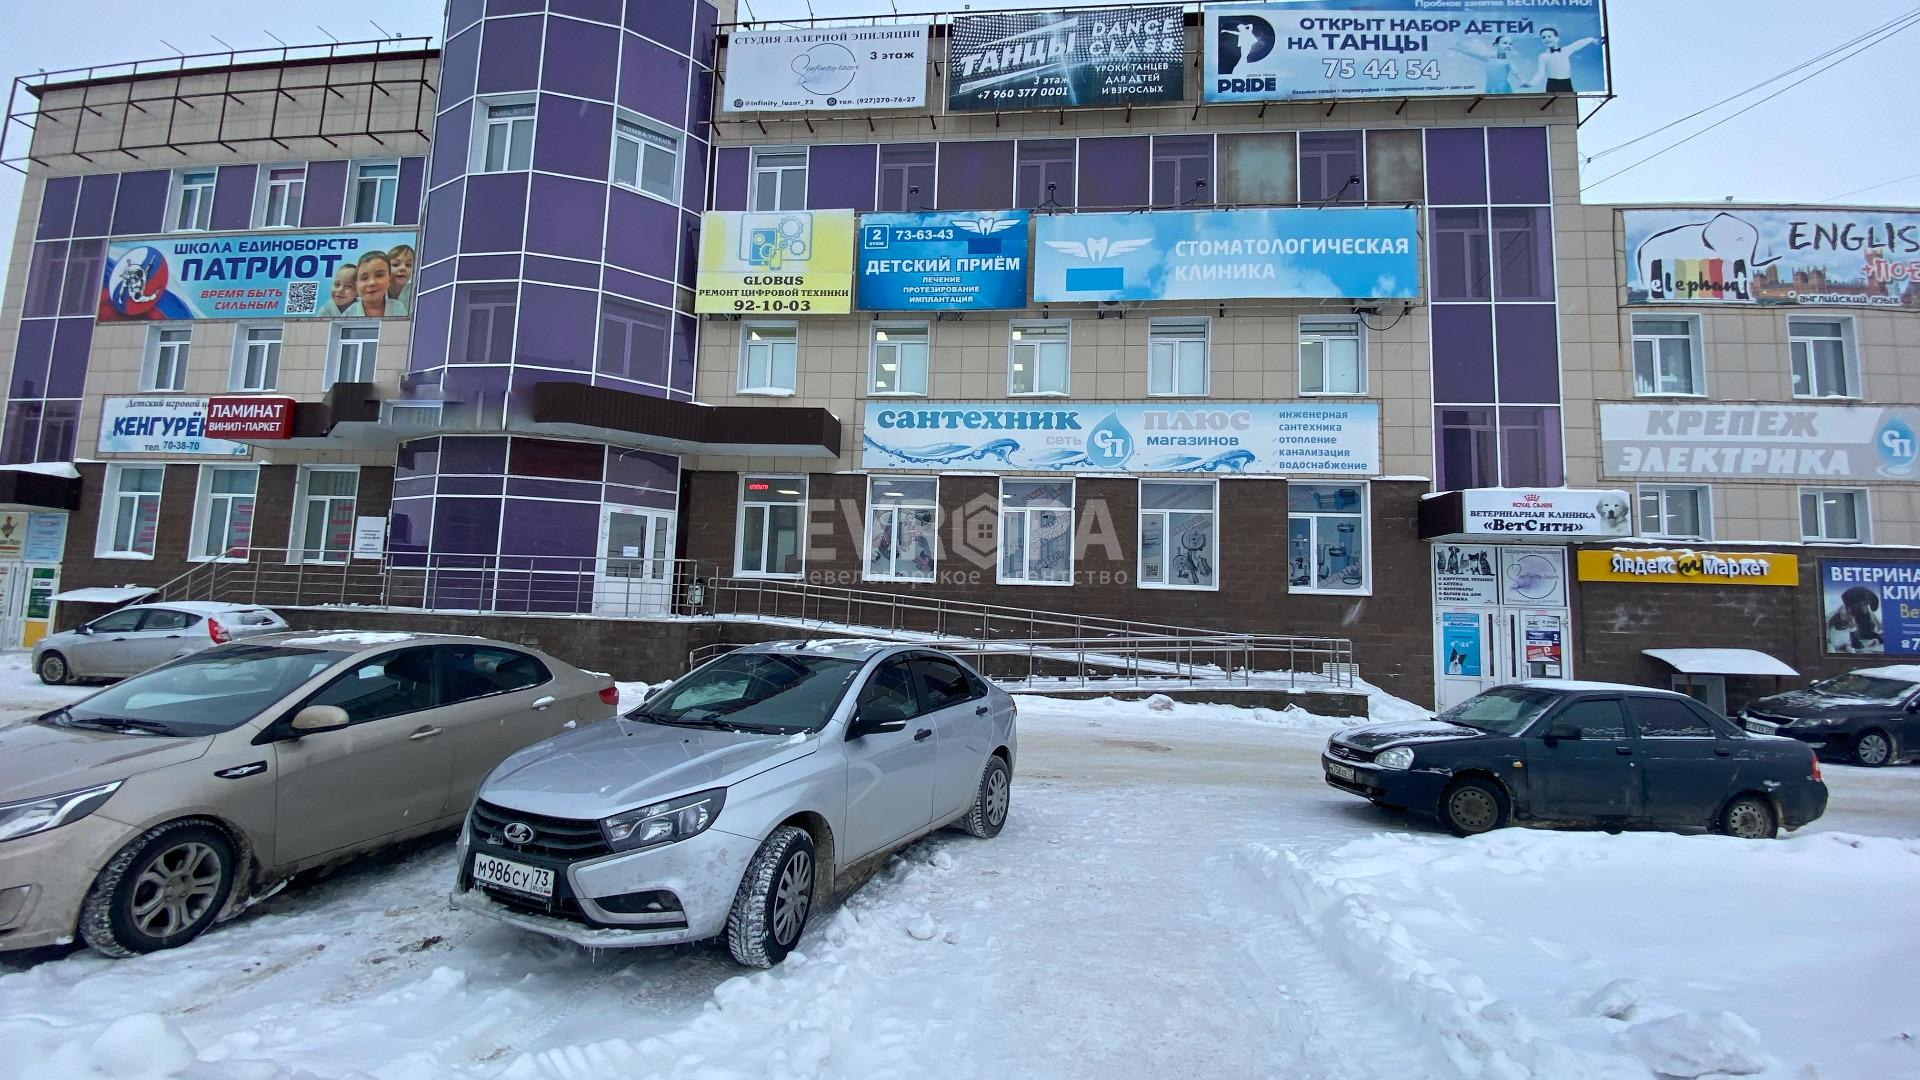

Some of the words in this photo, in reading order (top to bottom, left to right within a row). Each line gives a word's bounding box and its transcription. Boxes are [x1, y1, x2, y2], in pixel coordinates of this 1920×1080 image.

[1092, 17, 1176, 37] DANCE
[1300, 17, 1385, 31] ОТКРЫТ
[1390, 18, 1461, 32] НАБОР
[1465, 17, 1534, 35] ДЕТЕЙ
[735, 36, 781, 46] СТУДИЯ
[784, 32, 848, 44] ЛАЗЕРНОЙ
[851, 30, 920, 42] ЭПИЛЯЦИИ
[1287, 37, 1318, 51] НА
[1321, 34, 1428, 54] ТАНЦЫ
[1089, 37, 1176, 56] CLASS
[870, 51, 877, 60] 3
[881, 52, 915, 60] этаж
[960, 32, 1076, 77] ТАНЦЫ
[1095, 64, 1128, 73] УРОКИ
[1131, 62, 1169, 72] ТАНЦЕВ
[1322, 58, 1355, 80] 75
[1363, 58, 1398, 80] 44
[1406, 59, 1440, 80] 54
[1034, 75, 1040, 85] 3
[1042, 76, 1069, 85] этаж
[1105, 75, 1126, 84] ДЛЯ
[1128, 73, 1160, 84] ДЕТЕЙ
[1102, 87, 1109, 95] И
[1111, 85, 1163, 94] ВЗРОСЛЫХ
[1218, 77, 1276, 93] PRIDE
[978, 91, 989, 100] +7
[993, 89, 1014, 98] 960
[1017, 88, 1037, 97] 377
[1041, 87, 1068, 97] 0001
[857, 96, 916, 105] (927)270-76-27
[872, 229, 882, 240] 2
[896, 229, 954, 240] 73-63-43
[174, 241, 233, 255] ШКОЛА
[238, 238, 359, 254] ЕДИНОБОРСТВ
[1175, 237, 1409, 257] СТОМАТОЛОГИЧЕСКАЯ
[181, 254, 342, 282] ПАТРИОТ
[866, 255, 951, 275] ДЕТСКИЙ
[956, 255, 1020, 272] ПРИЁМ
[1175, 264, 1276, 281] КЛИНИКА
[743, 275, 804, 286] GLOBUS
[922, 276, 961, 284] ЛЕЧЕНИЕ
[1650, 270, 1749, 299] elephant
[200, 288, 245, 299] ВРЕМЯ
[247, 287, 283, 299] БЫТЬ
[699, 289, 739, 297] РЕМОНТ
[741, 287, 800, 298] ЦИФРОВОЙ
[801, 289, 849, 298] ТЕХНИКИ
[903, 285, 980, 294] ПРОТЕЗИРОВАНИЕ
[909, 295, 974, 304] ИМПЛАНТАЦИЯ
[1800, 294, 1867, 305] английский
[214, 300, 279, 312] СИЛЬНЫМ
[733, 300, 811, 312] 92-10-03
[125, 399, 164, 409] Детский
[166, 399, 201, 410] игровой
[210, 404, 284, 418] ЛАМИНАТ
[1279, 410, 1348, 420] инженерная
[877, 410, 1082, 430] сантехник
[1646, 410, 1819, 437] КРЕПЕЖ
[1279, 423, 1342, 432] сантехника
[1046, 435, 1082, 446] сеть
[1146, 435, 1239, 446] магазинов
[1279, 435, 1337, 444] отопление
[144, 444, 161, 452] тел.
[163, 441, 200, 451] 70-38-70
[1279, 447, 1350, 458] канализация
[1279, 460, 1368, 471] водоснабжение
[1617, 446, 1851, 475] ЭЛЕКТРИКА
[1470, 510, 1545, 519] ВЕТЕРИНАРНАЯ
[1548, 511, 1596, 519] КЛИНИКА
[1612, 553, 1677, 575] Яндекс
[1702, 553, 1770, 577] Маркет
[535, 869, 549, 887] 73
